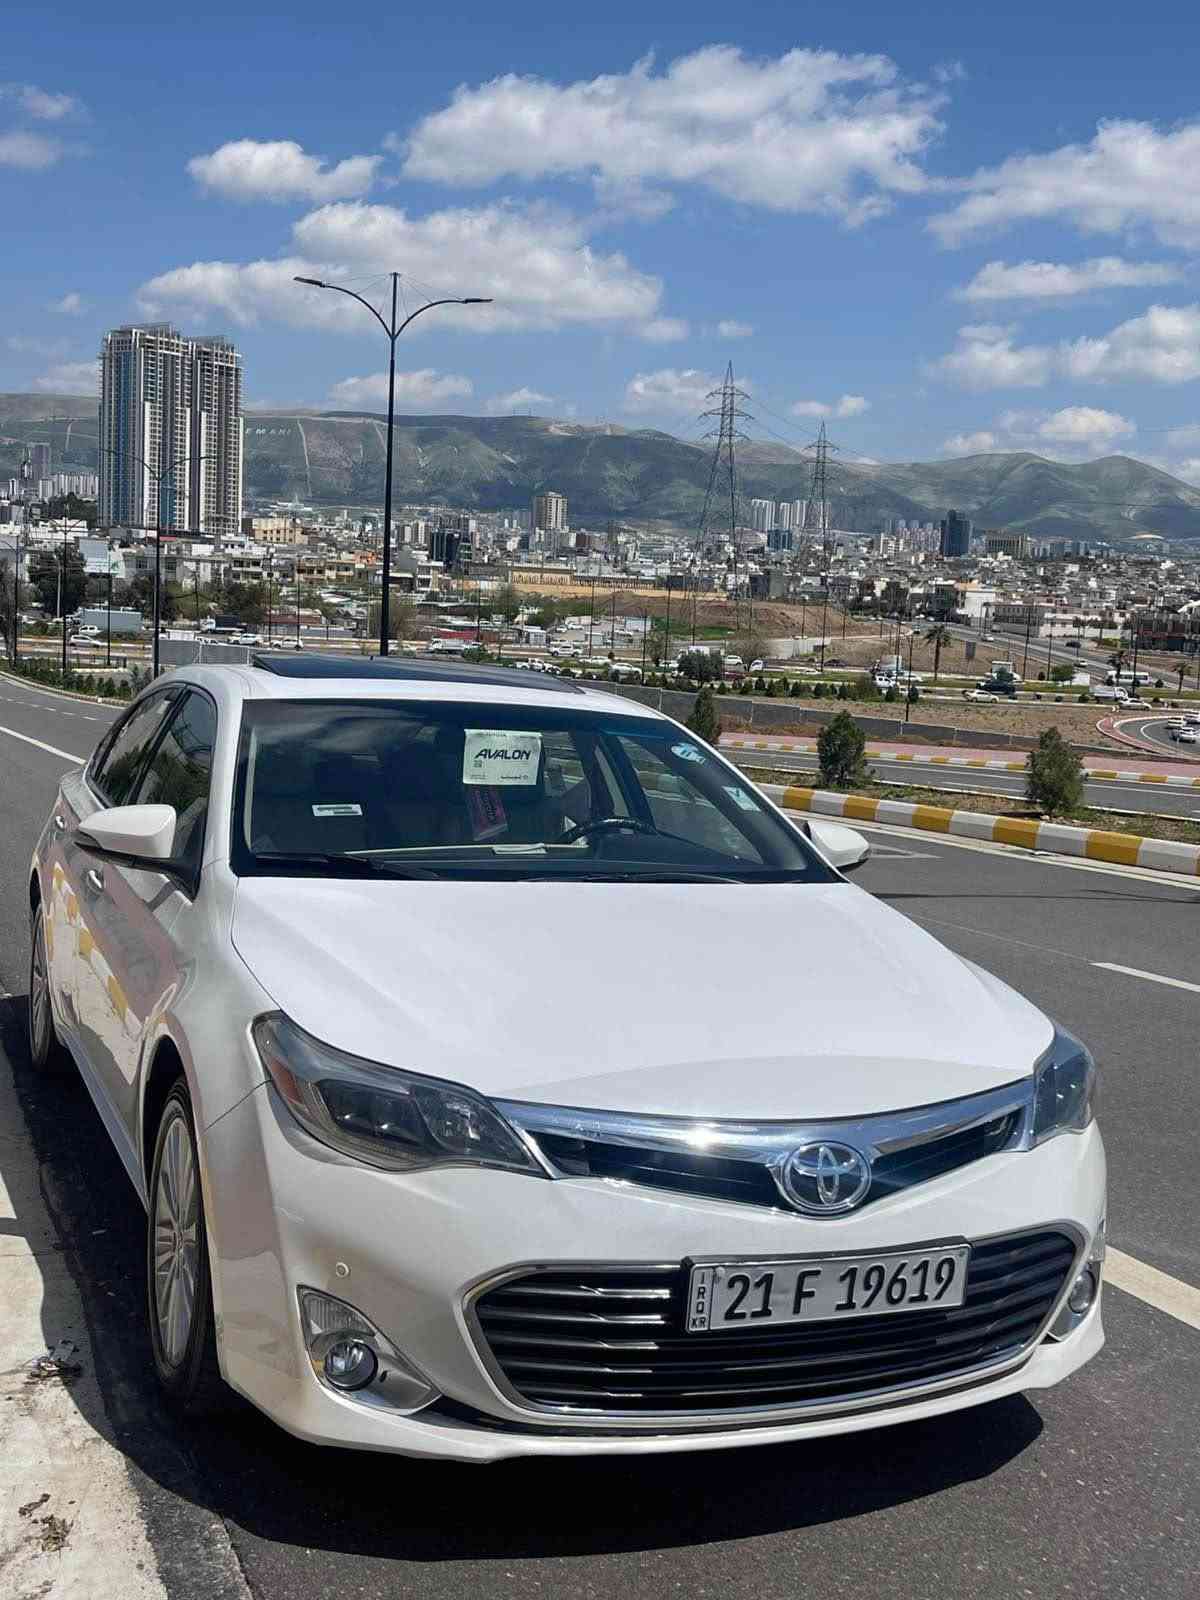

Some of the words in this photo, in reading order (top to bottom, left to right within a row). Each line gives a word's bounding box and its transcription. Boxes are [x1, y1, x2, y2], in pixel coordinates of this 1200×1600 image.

[474, 748, 532, 761] AVALON
[723, 1272, 775, 1321] 21
[792, 1268, 822, 1316] F
[834, 1255, 957, 1313] 19619
